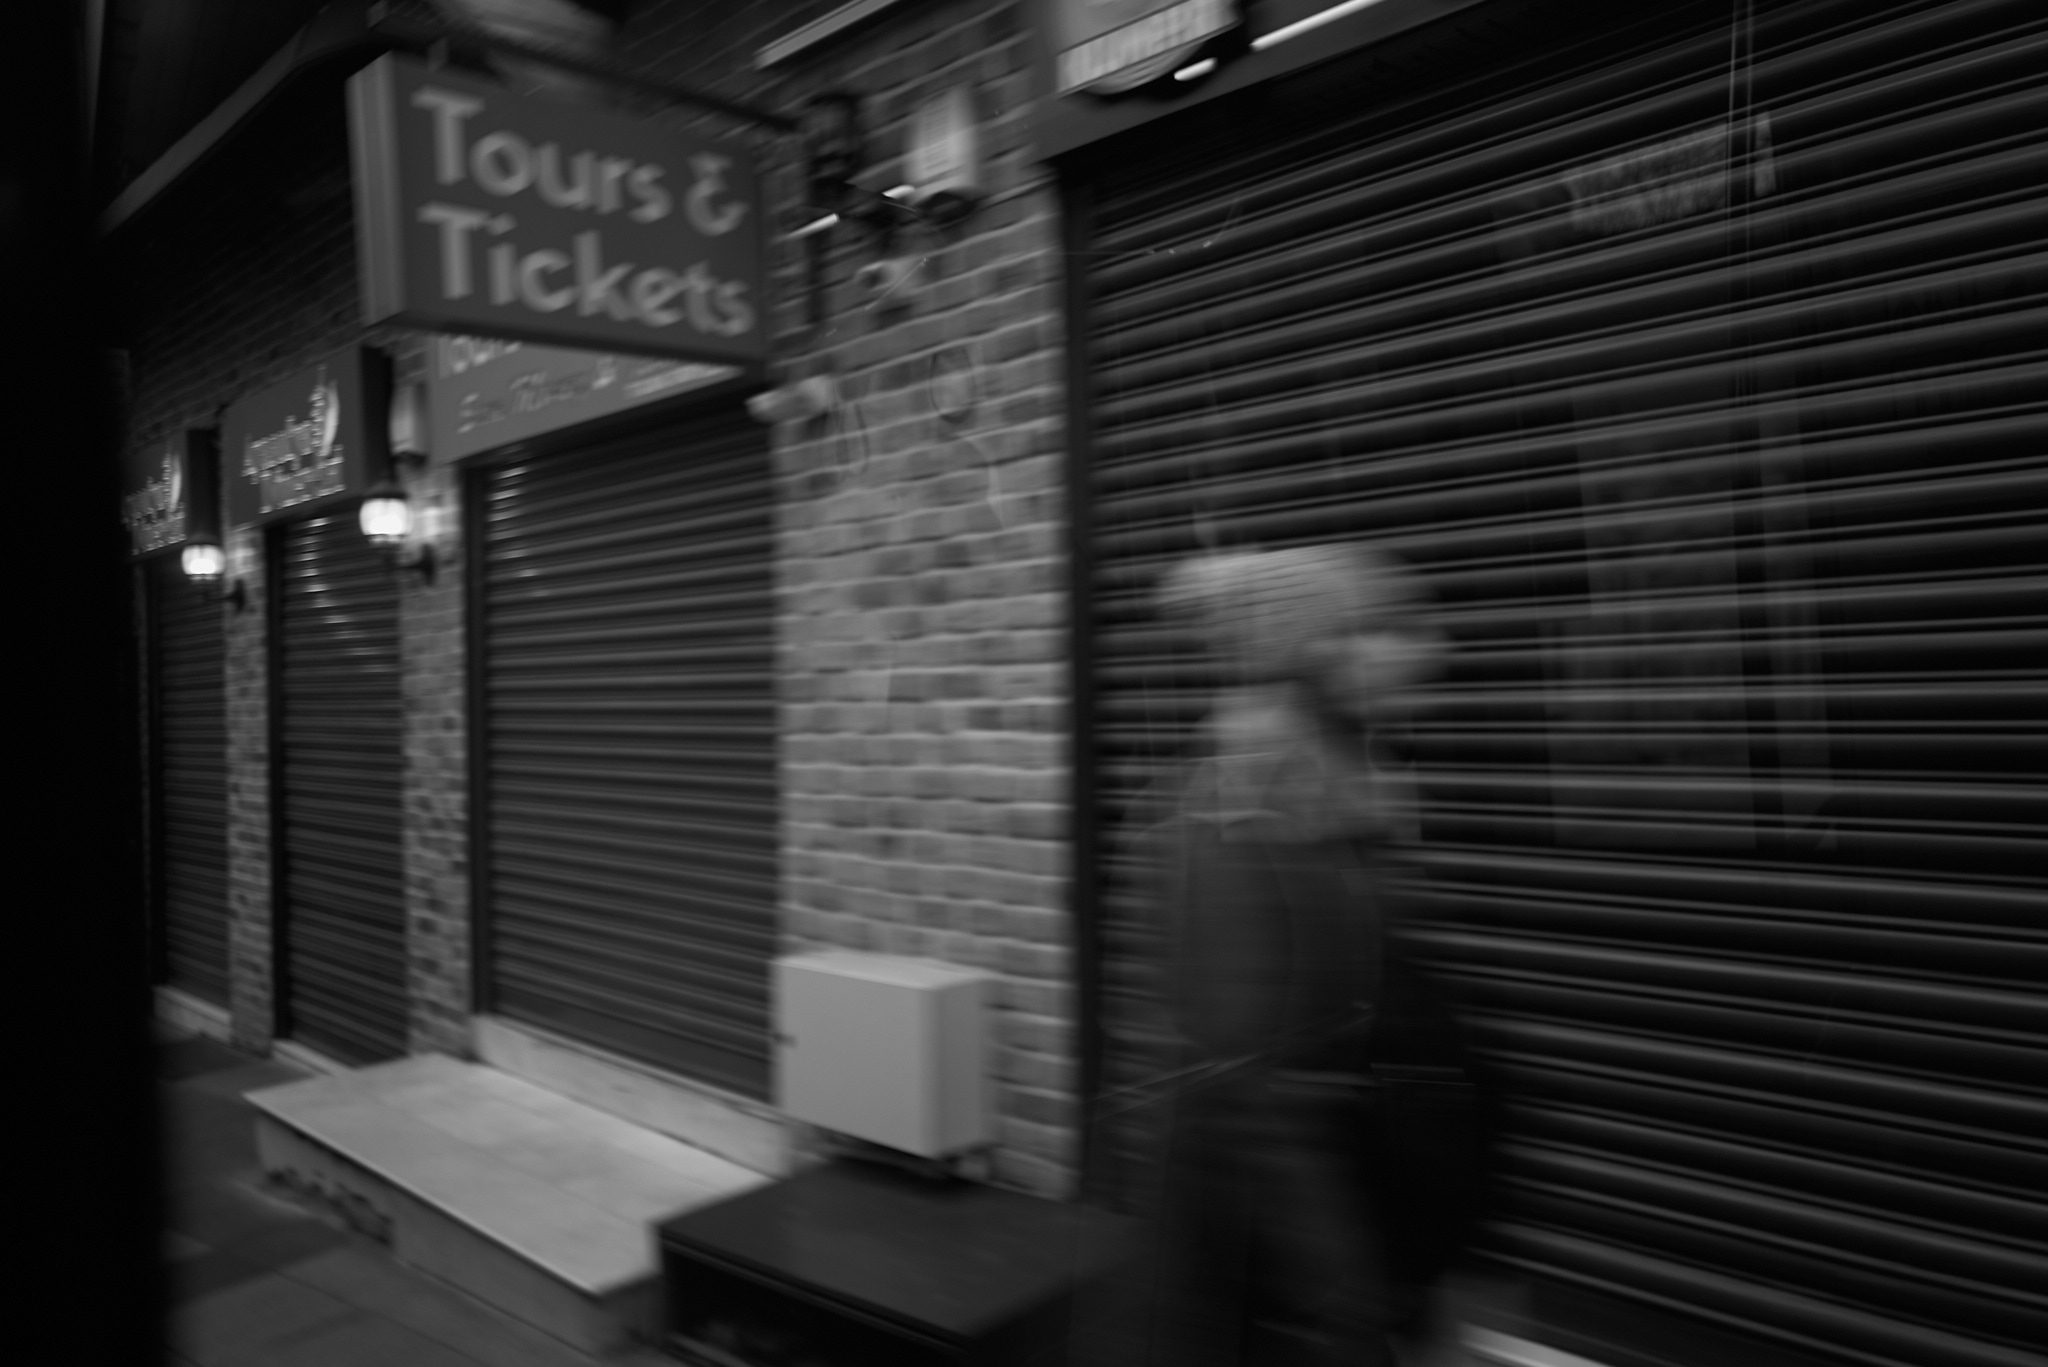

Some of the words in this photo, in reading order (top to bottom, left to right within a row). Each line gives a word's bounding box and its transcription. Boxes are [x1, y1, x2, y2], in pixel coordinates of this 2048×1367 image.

[411, 88, 674, 224] Tours
[684, 152, 748, 236] &
[416, 201, 756, 336] Tickets
